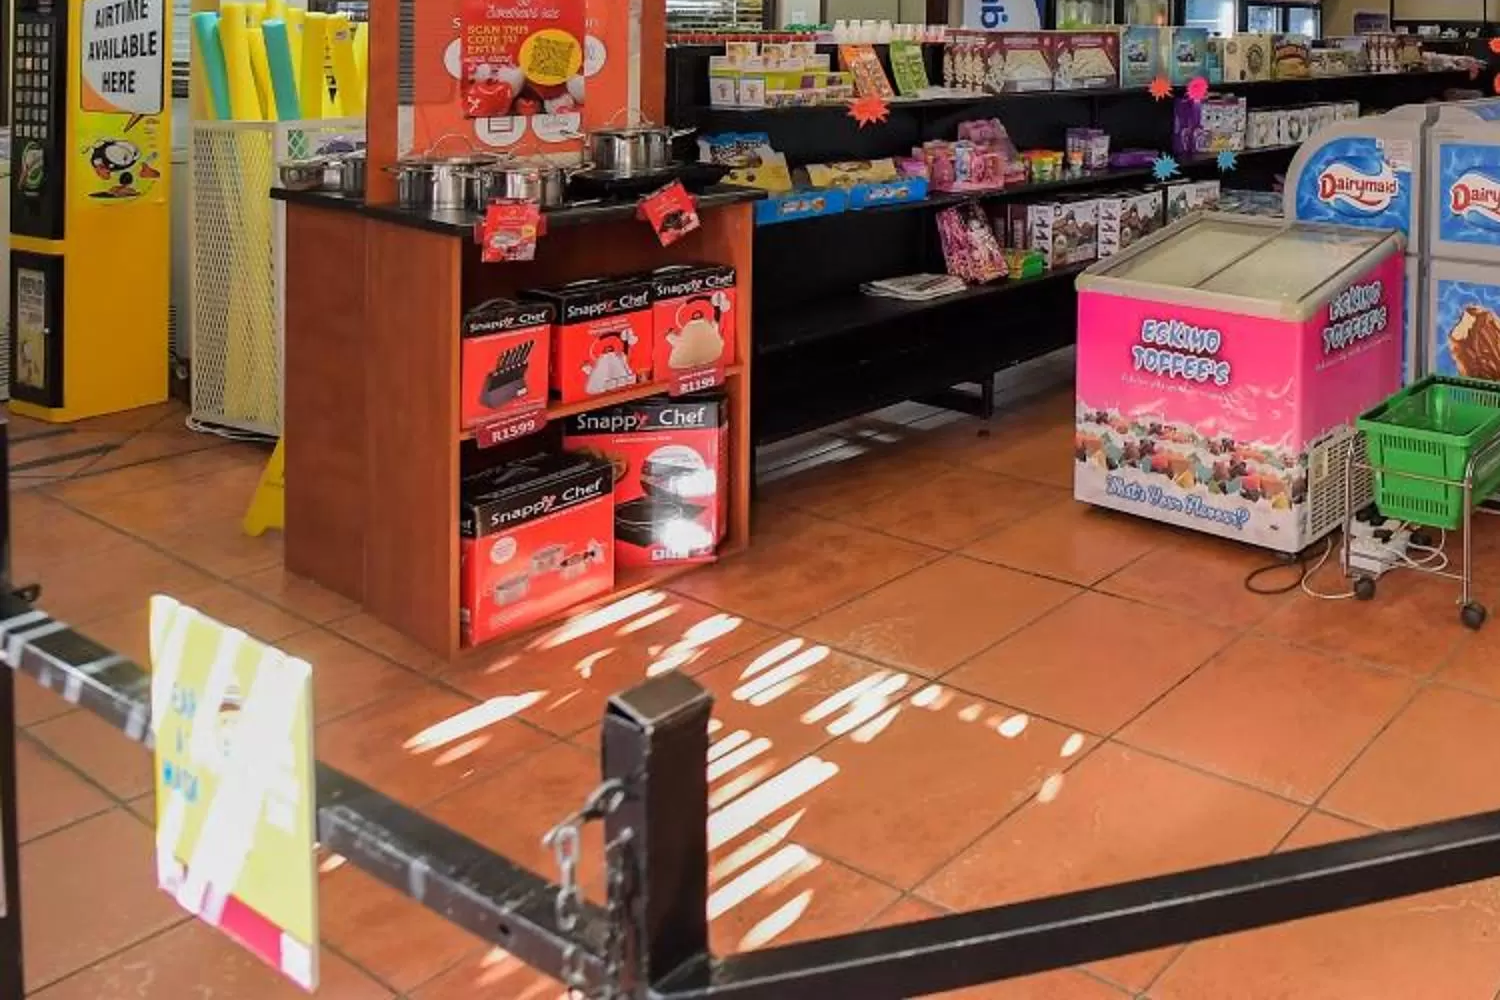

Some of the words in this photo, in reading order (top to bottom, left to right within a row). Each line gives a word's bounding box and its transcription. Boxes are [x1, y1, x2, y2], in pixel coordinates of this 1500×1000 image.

[88, 31, 157, 61] AVAILABLE
[102, 70, 136, 94] HERE
[1320, 172, 1398, 201] Dairymaid
[657, 279, 702, 296] Snappy
[705, 270, 735, 287] Chef
[568, 300, 617, 318] Snappy
[619, 292, 649, 307] Chef
[1329, 281, 1381, 321] ESKIMO
[469, 316, 514, 332] Snappy
[518, 310, 549, 323] Chef
[1141, 319, 1221, 354] ESKIMO
[1132, 345, 1231, 386] TOFFEE'S
[577, 411, 649, 432] Snappy
[659, 407, 705, 425] Chef
[491, 494, 557, 526] Snappy
[562, 478, 603, 501] Chef
